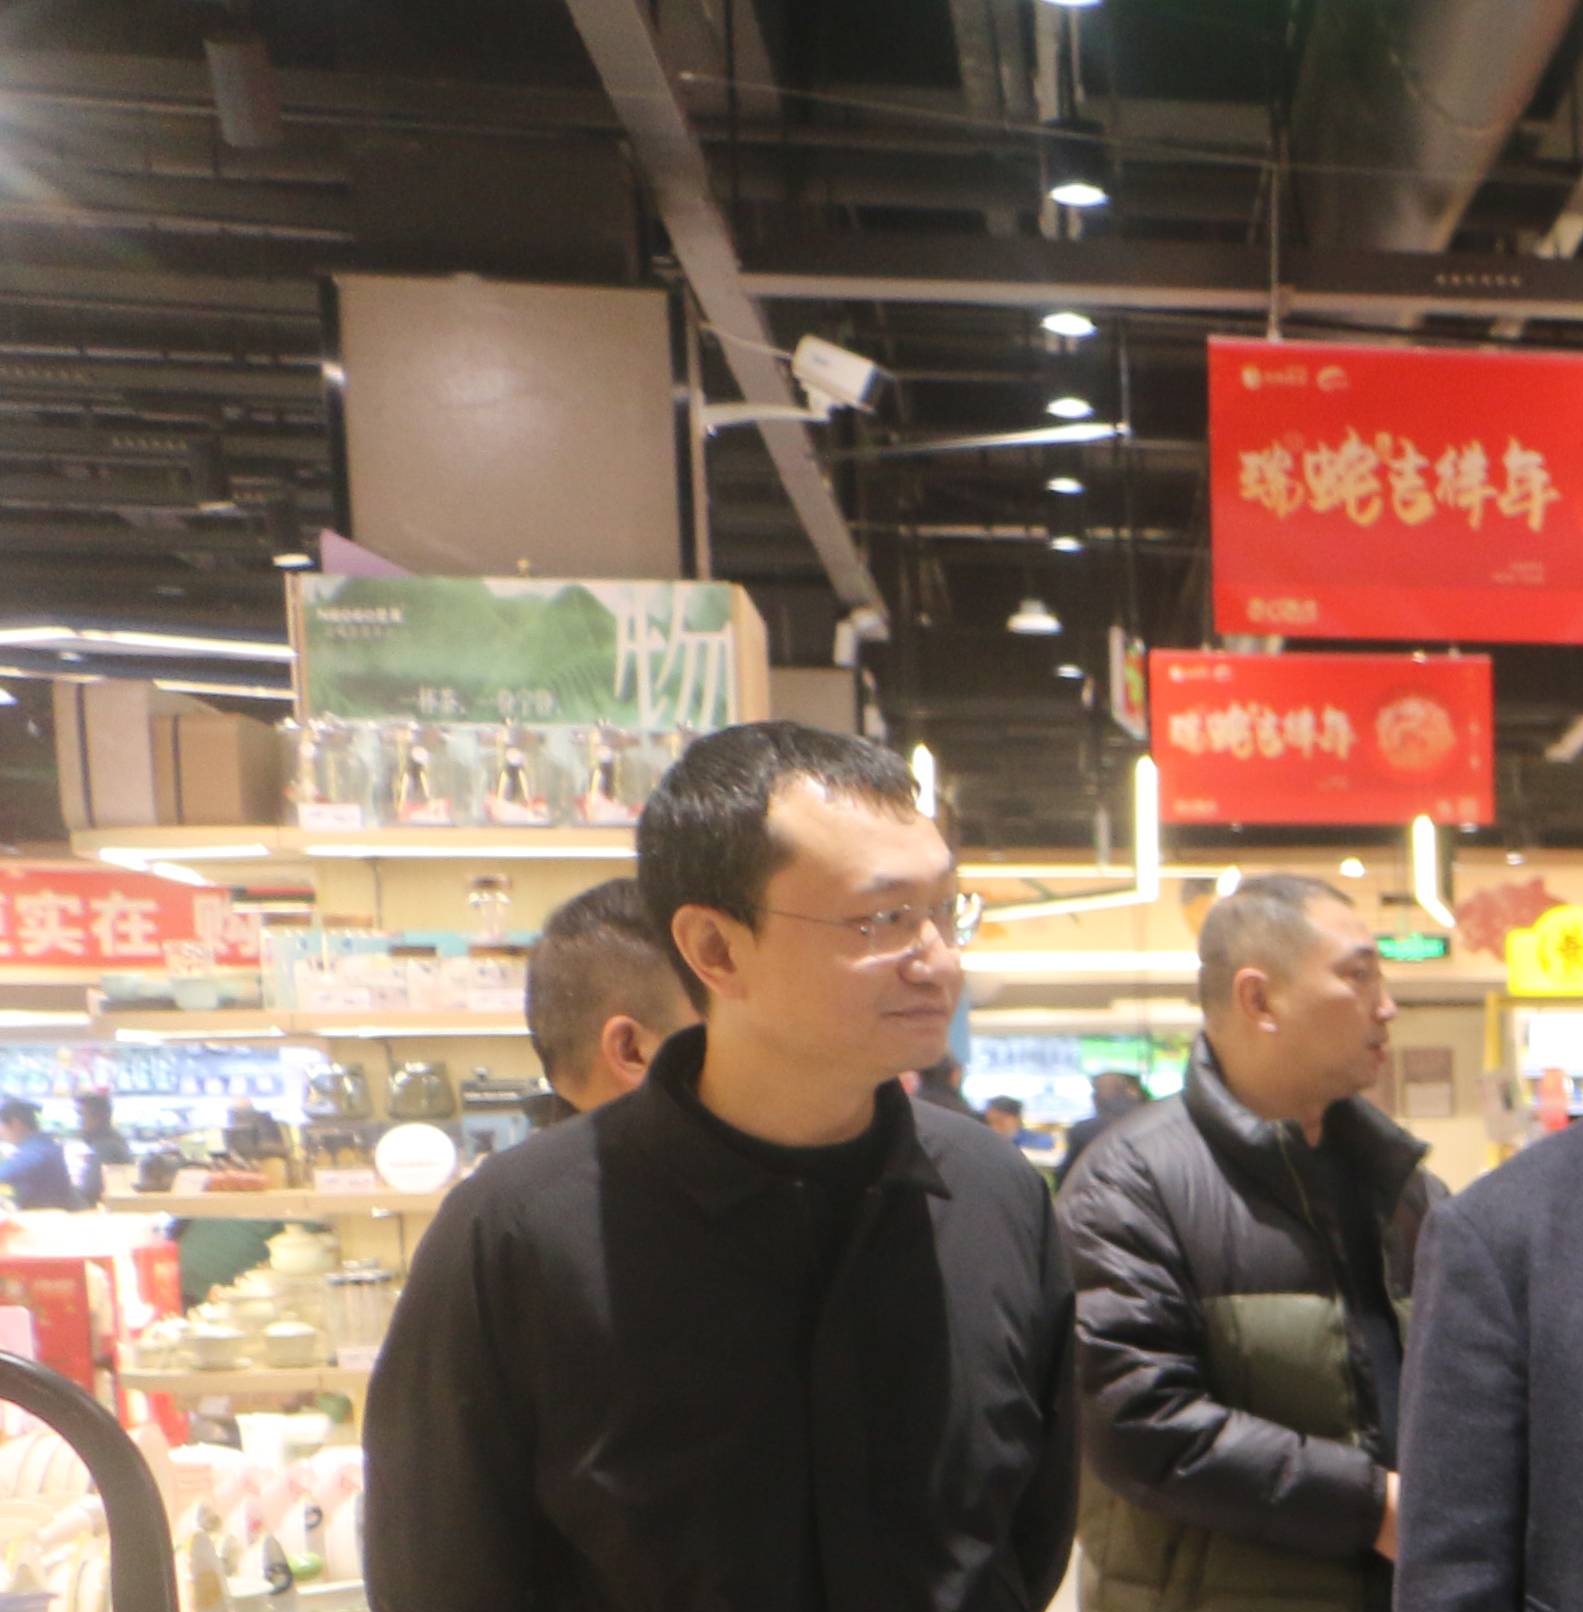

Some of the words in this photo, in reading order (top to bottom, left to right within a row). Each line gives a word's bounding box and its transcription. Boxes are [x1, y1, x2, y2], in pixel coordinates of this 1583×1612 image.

[1238, 427, 1560, 533] 瑞蛇吉祥年
